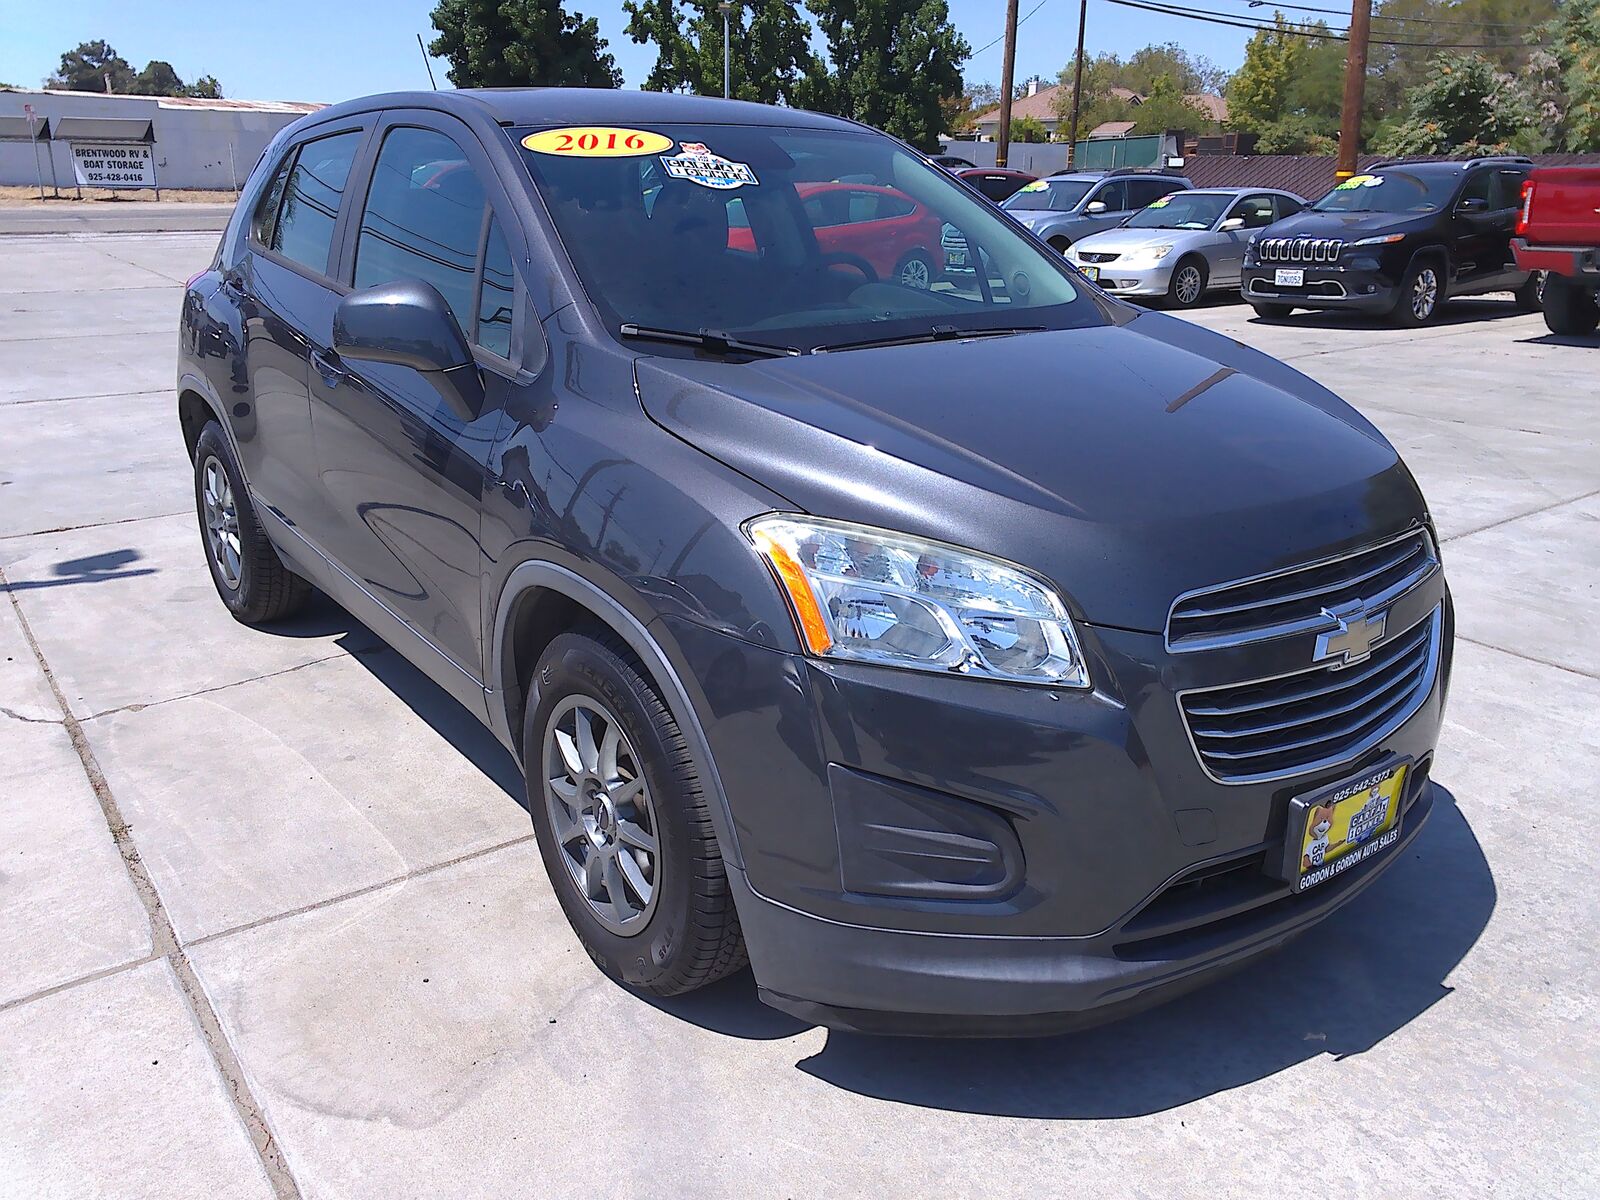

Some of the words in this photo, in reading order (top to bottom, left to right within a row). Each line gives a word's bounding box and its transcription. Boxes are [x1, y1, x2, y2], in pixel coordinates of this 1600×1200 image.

[555, 133, 645, 151] 2016
[75, 148, 127, 159] BRENTWOOD
[129, 149, 140, 159] RV
[143, 150, 150, 159] &
[83, 159, 104, 169] BOAT
[107, 160, 144, 170] STORAGE
[668, 159, 744, 174] CARFAX
[88, 172, 143, 182] 925-428-0416
[686, 168, 751, 182] OWNER
[1332, 769, 1391, 803] 925-642-5373
[1352, 800, 1387, 827] CARFAX
[1355, 812, 1385, 836] OWNER
[1300, 867, 1330, 890] GORDON
[1329, 863, 1336, 877] &
[1335, 850, 1361, 873] GORDON
[1361, 841, 1379, 860] AUTO
[1379, 829, 1398, 848] SALES
